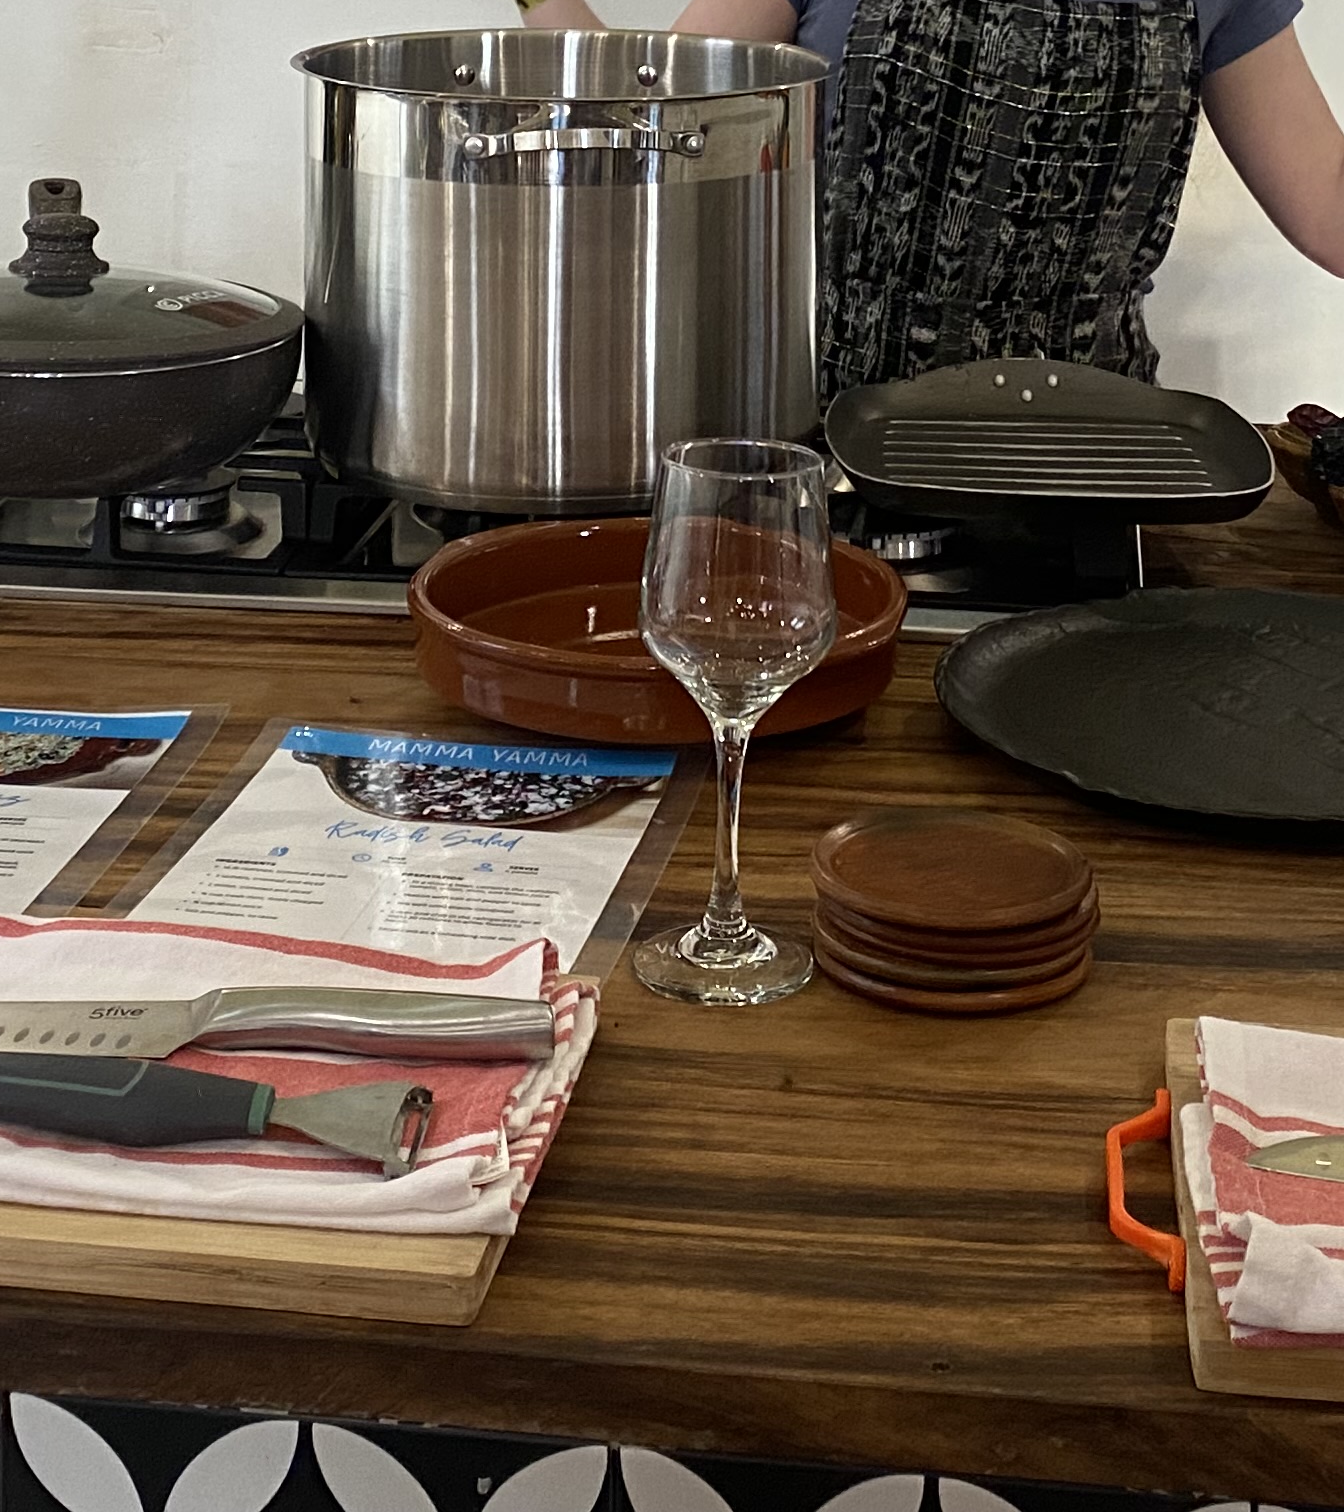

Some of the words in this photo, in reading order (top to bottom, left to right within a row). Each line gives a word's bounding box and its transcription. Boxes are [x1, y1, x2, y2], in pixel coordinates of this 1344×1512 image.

[12, 716, 103, 731] YAMMA
[368, 738, 473, 761] MAMMA
[493, 749, 588, 767] YAMMA
[325, 820, 431, 844] Radish
[441, 829, 524, 853] Salad
